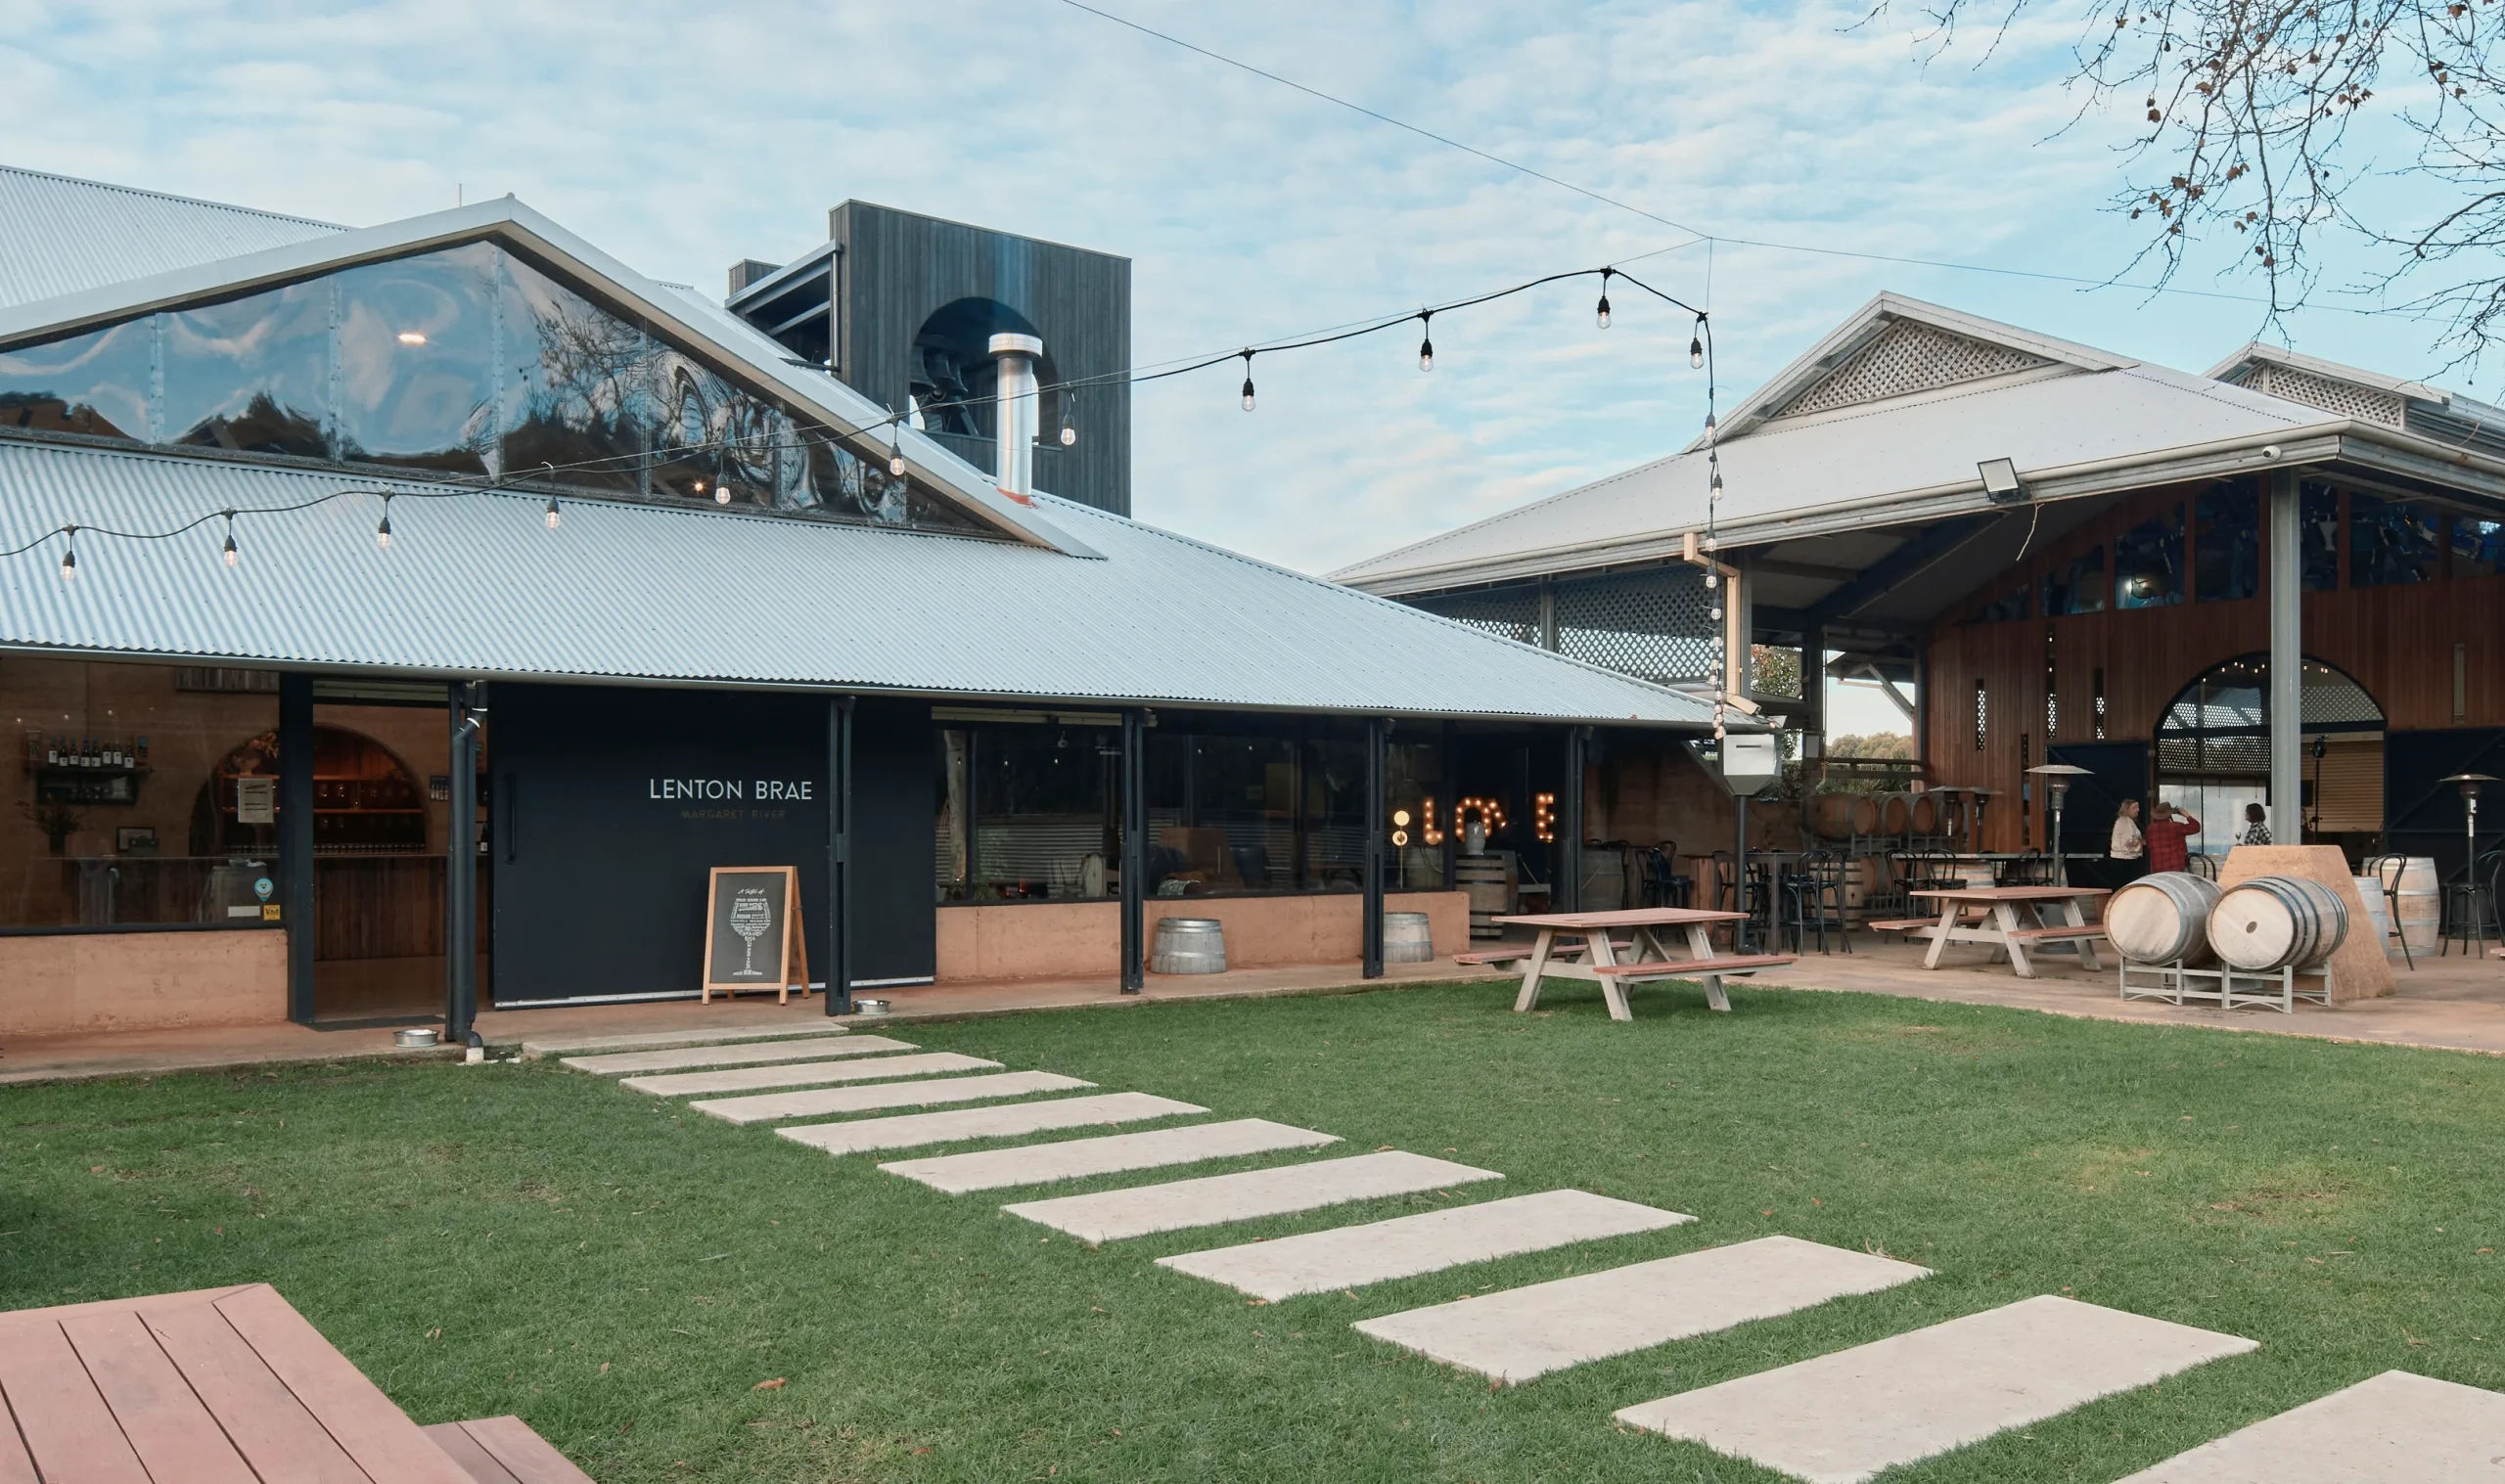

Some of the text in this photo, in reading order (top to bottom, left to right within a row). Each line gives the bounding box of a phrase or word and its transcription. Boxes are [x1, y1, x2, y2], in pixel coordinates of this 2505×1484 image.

[650, 779, 813, 800] LENTON BRAE
[680, 809, 785, 819] MARGARET RIVER
